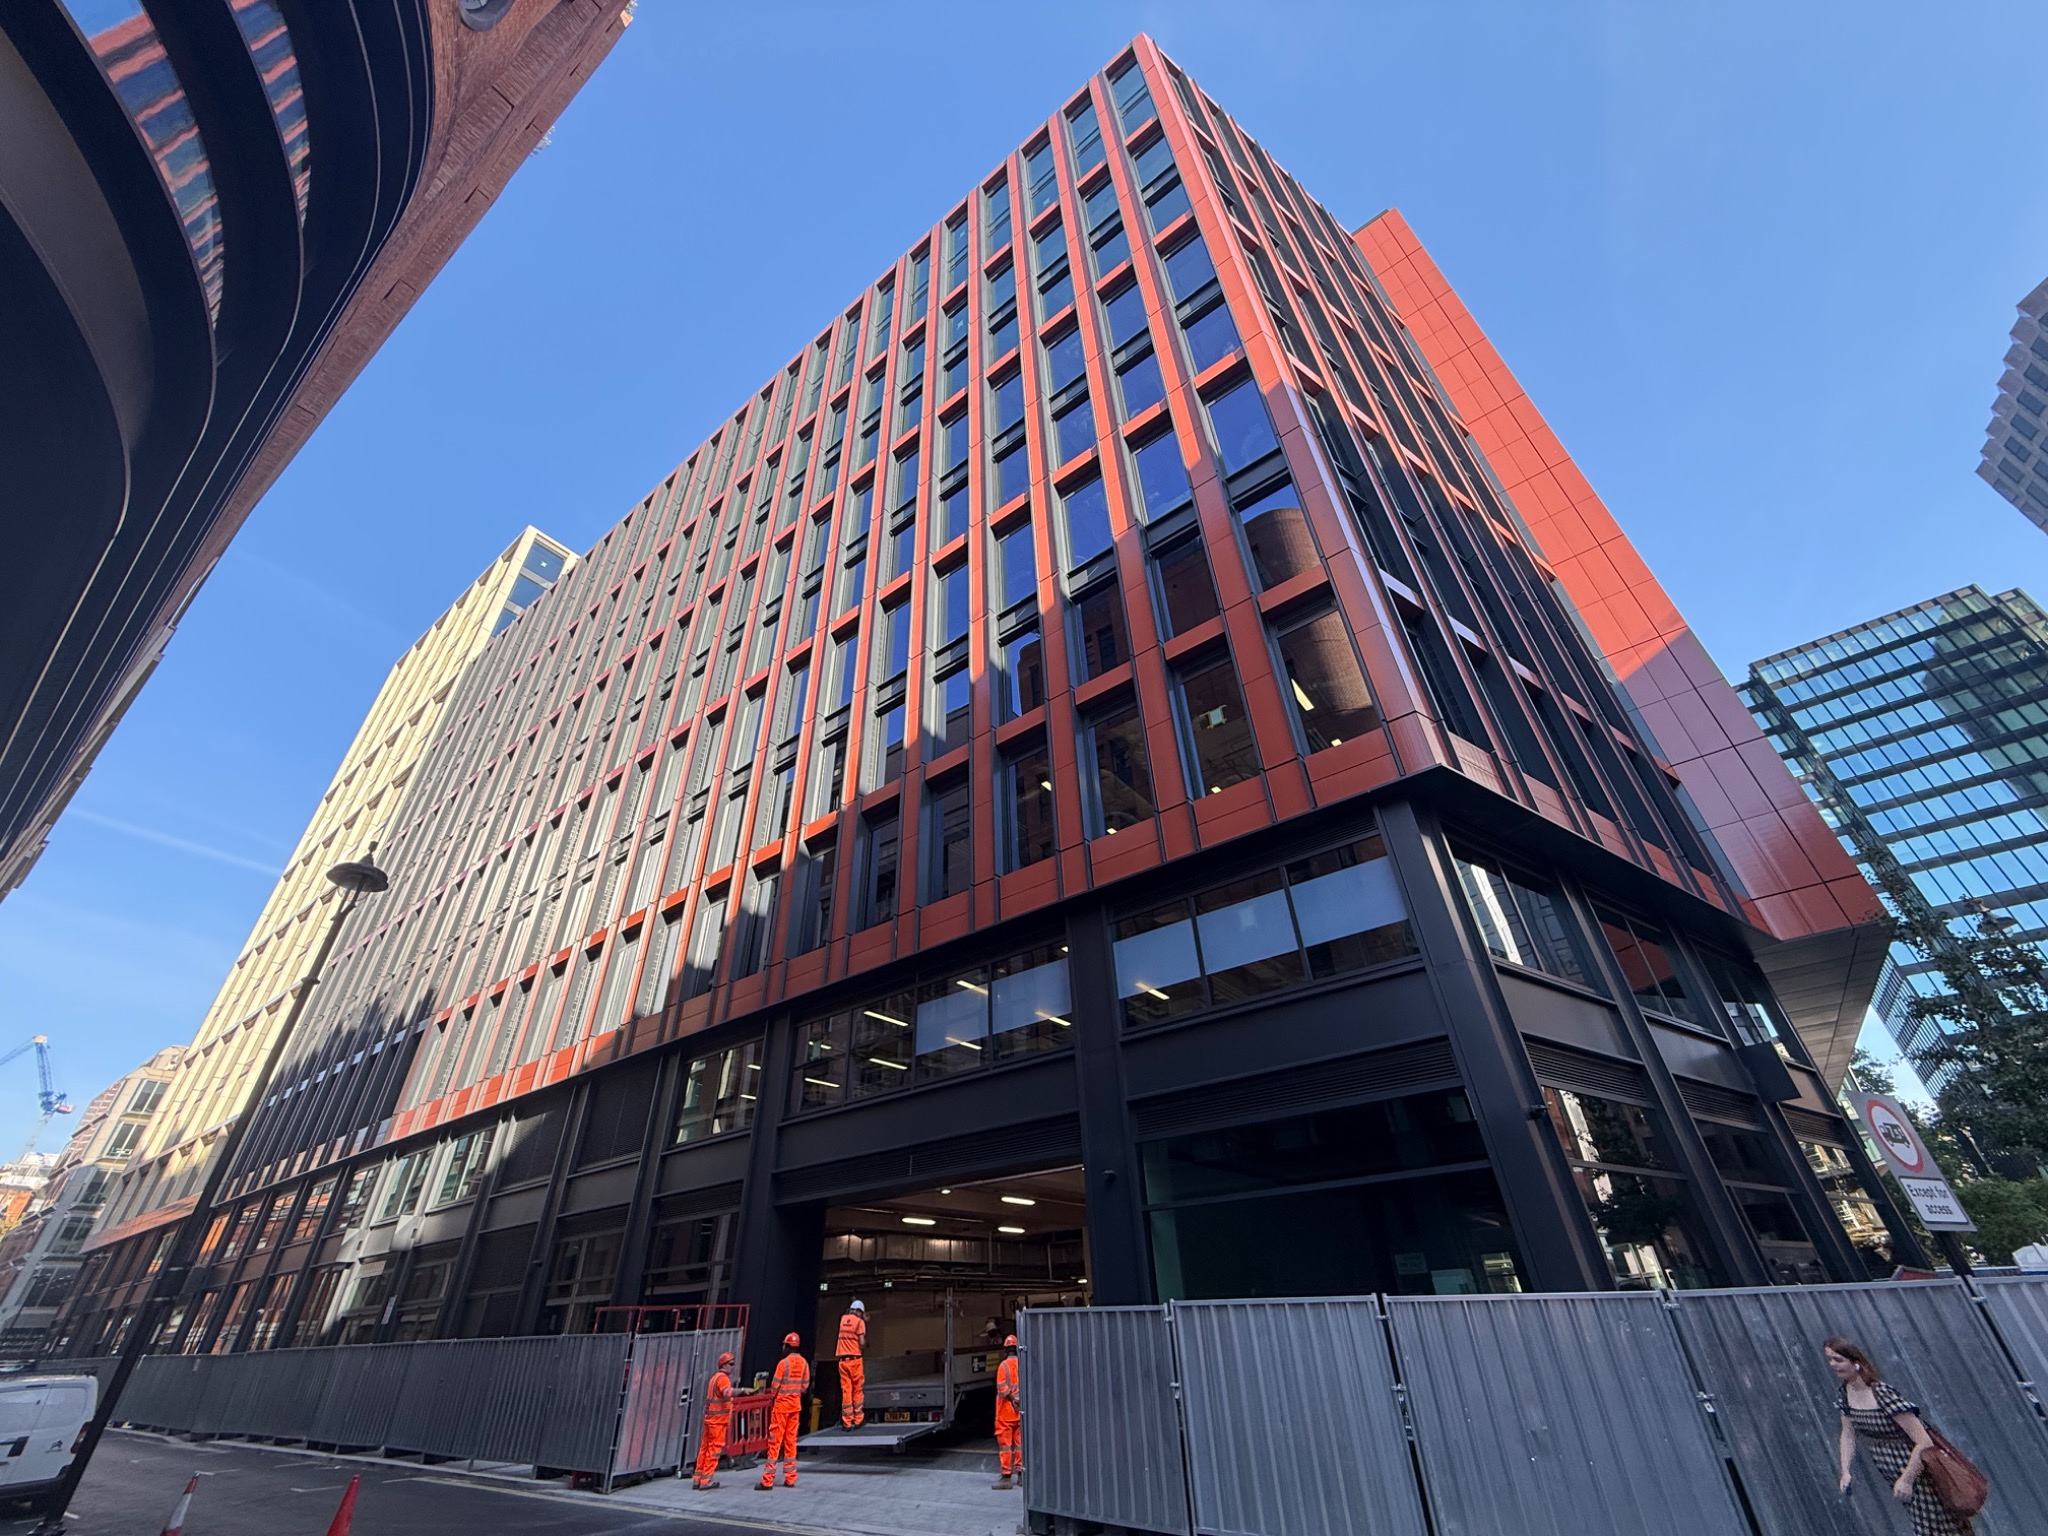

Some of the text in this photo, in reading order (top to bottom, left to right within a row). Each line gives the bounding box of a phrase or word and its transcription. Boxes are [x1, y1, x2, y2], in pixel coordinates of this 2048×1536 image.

[1907, 1184, 1949, 1200] Except for
[1925, 1204, 1953, 1215] access
